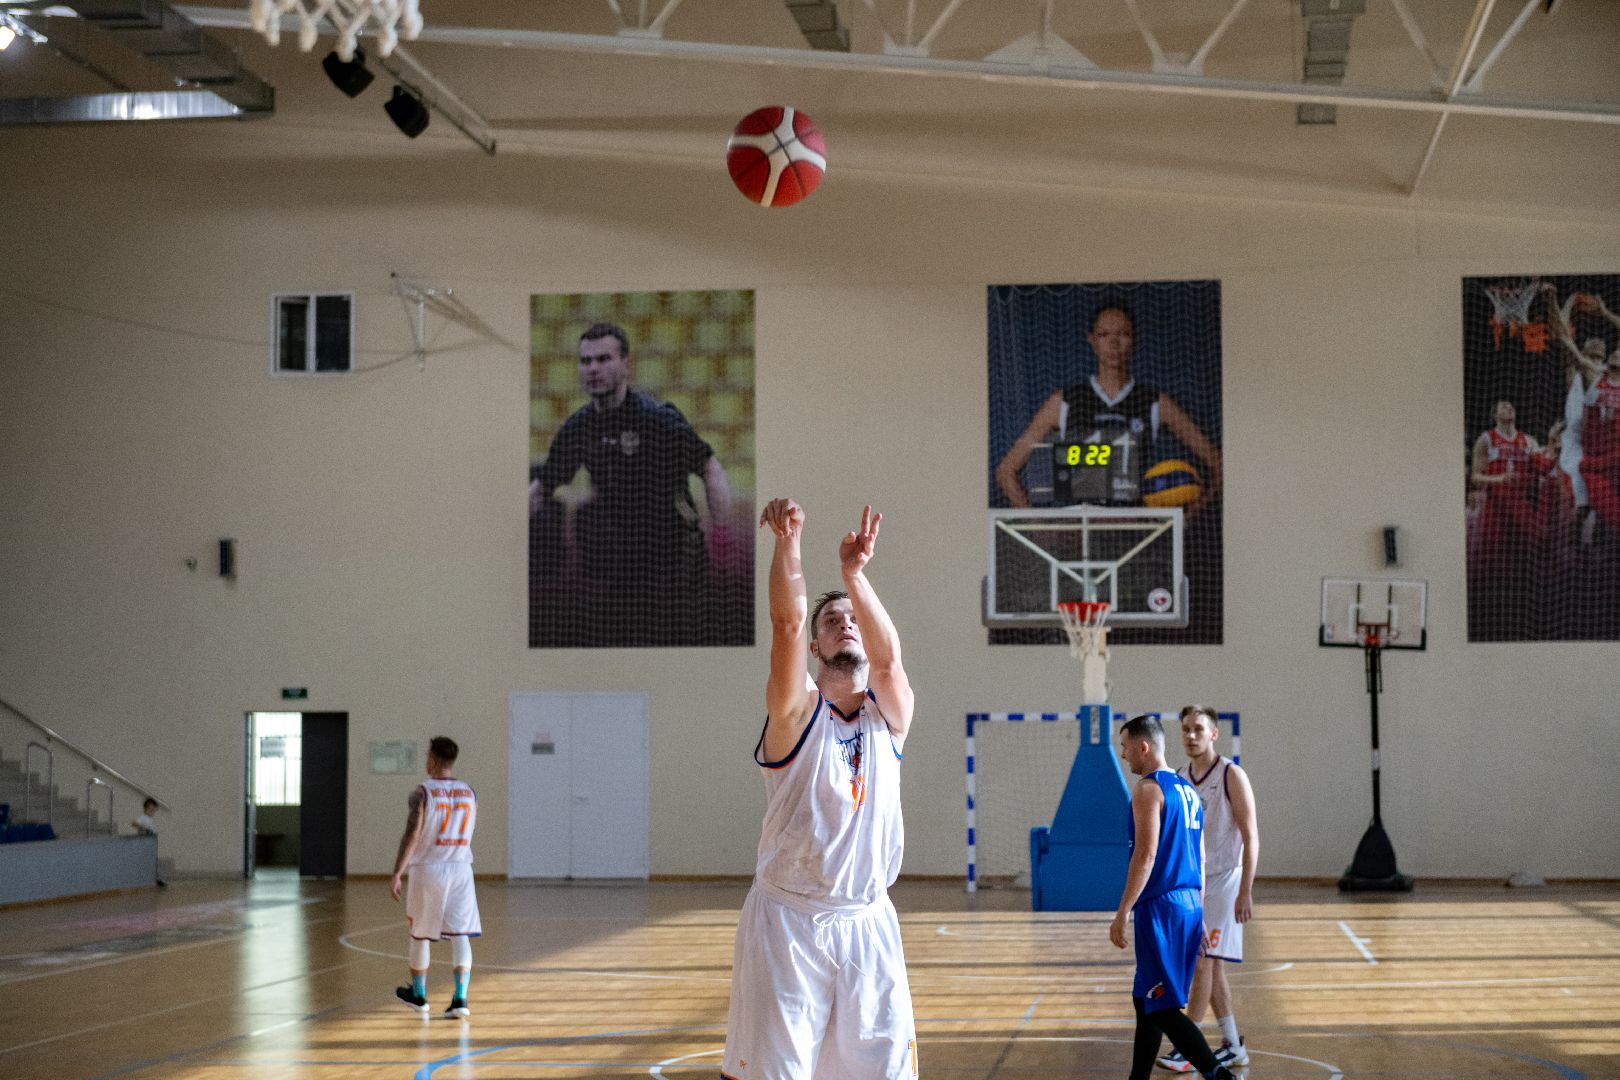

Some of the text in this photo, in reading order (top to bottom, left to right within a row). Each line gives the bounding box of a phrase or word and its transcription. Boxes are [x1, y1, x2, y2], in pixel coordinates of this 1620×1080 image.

[1066, 444, 1112, 466] 8 22
[436, 802, 471, 834] 77
[1173, 783, 1200, 829] 12
